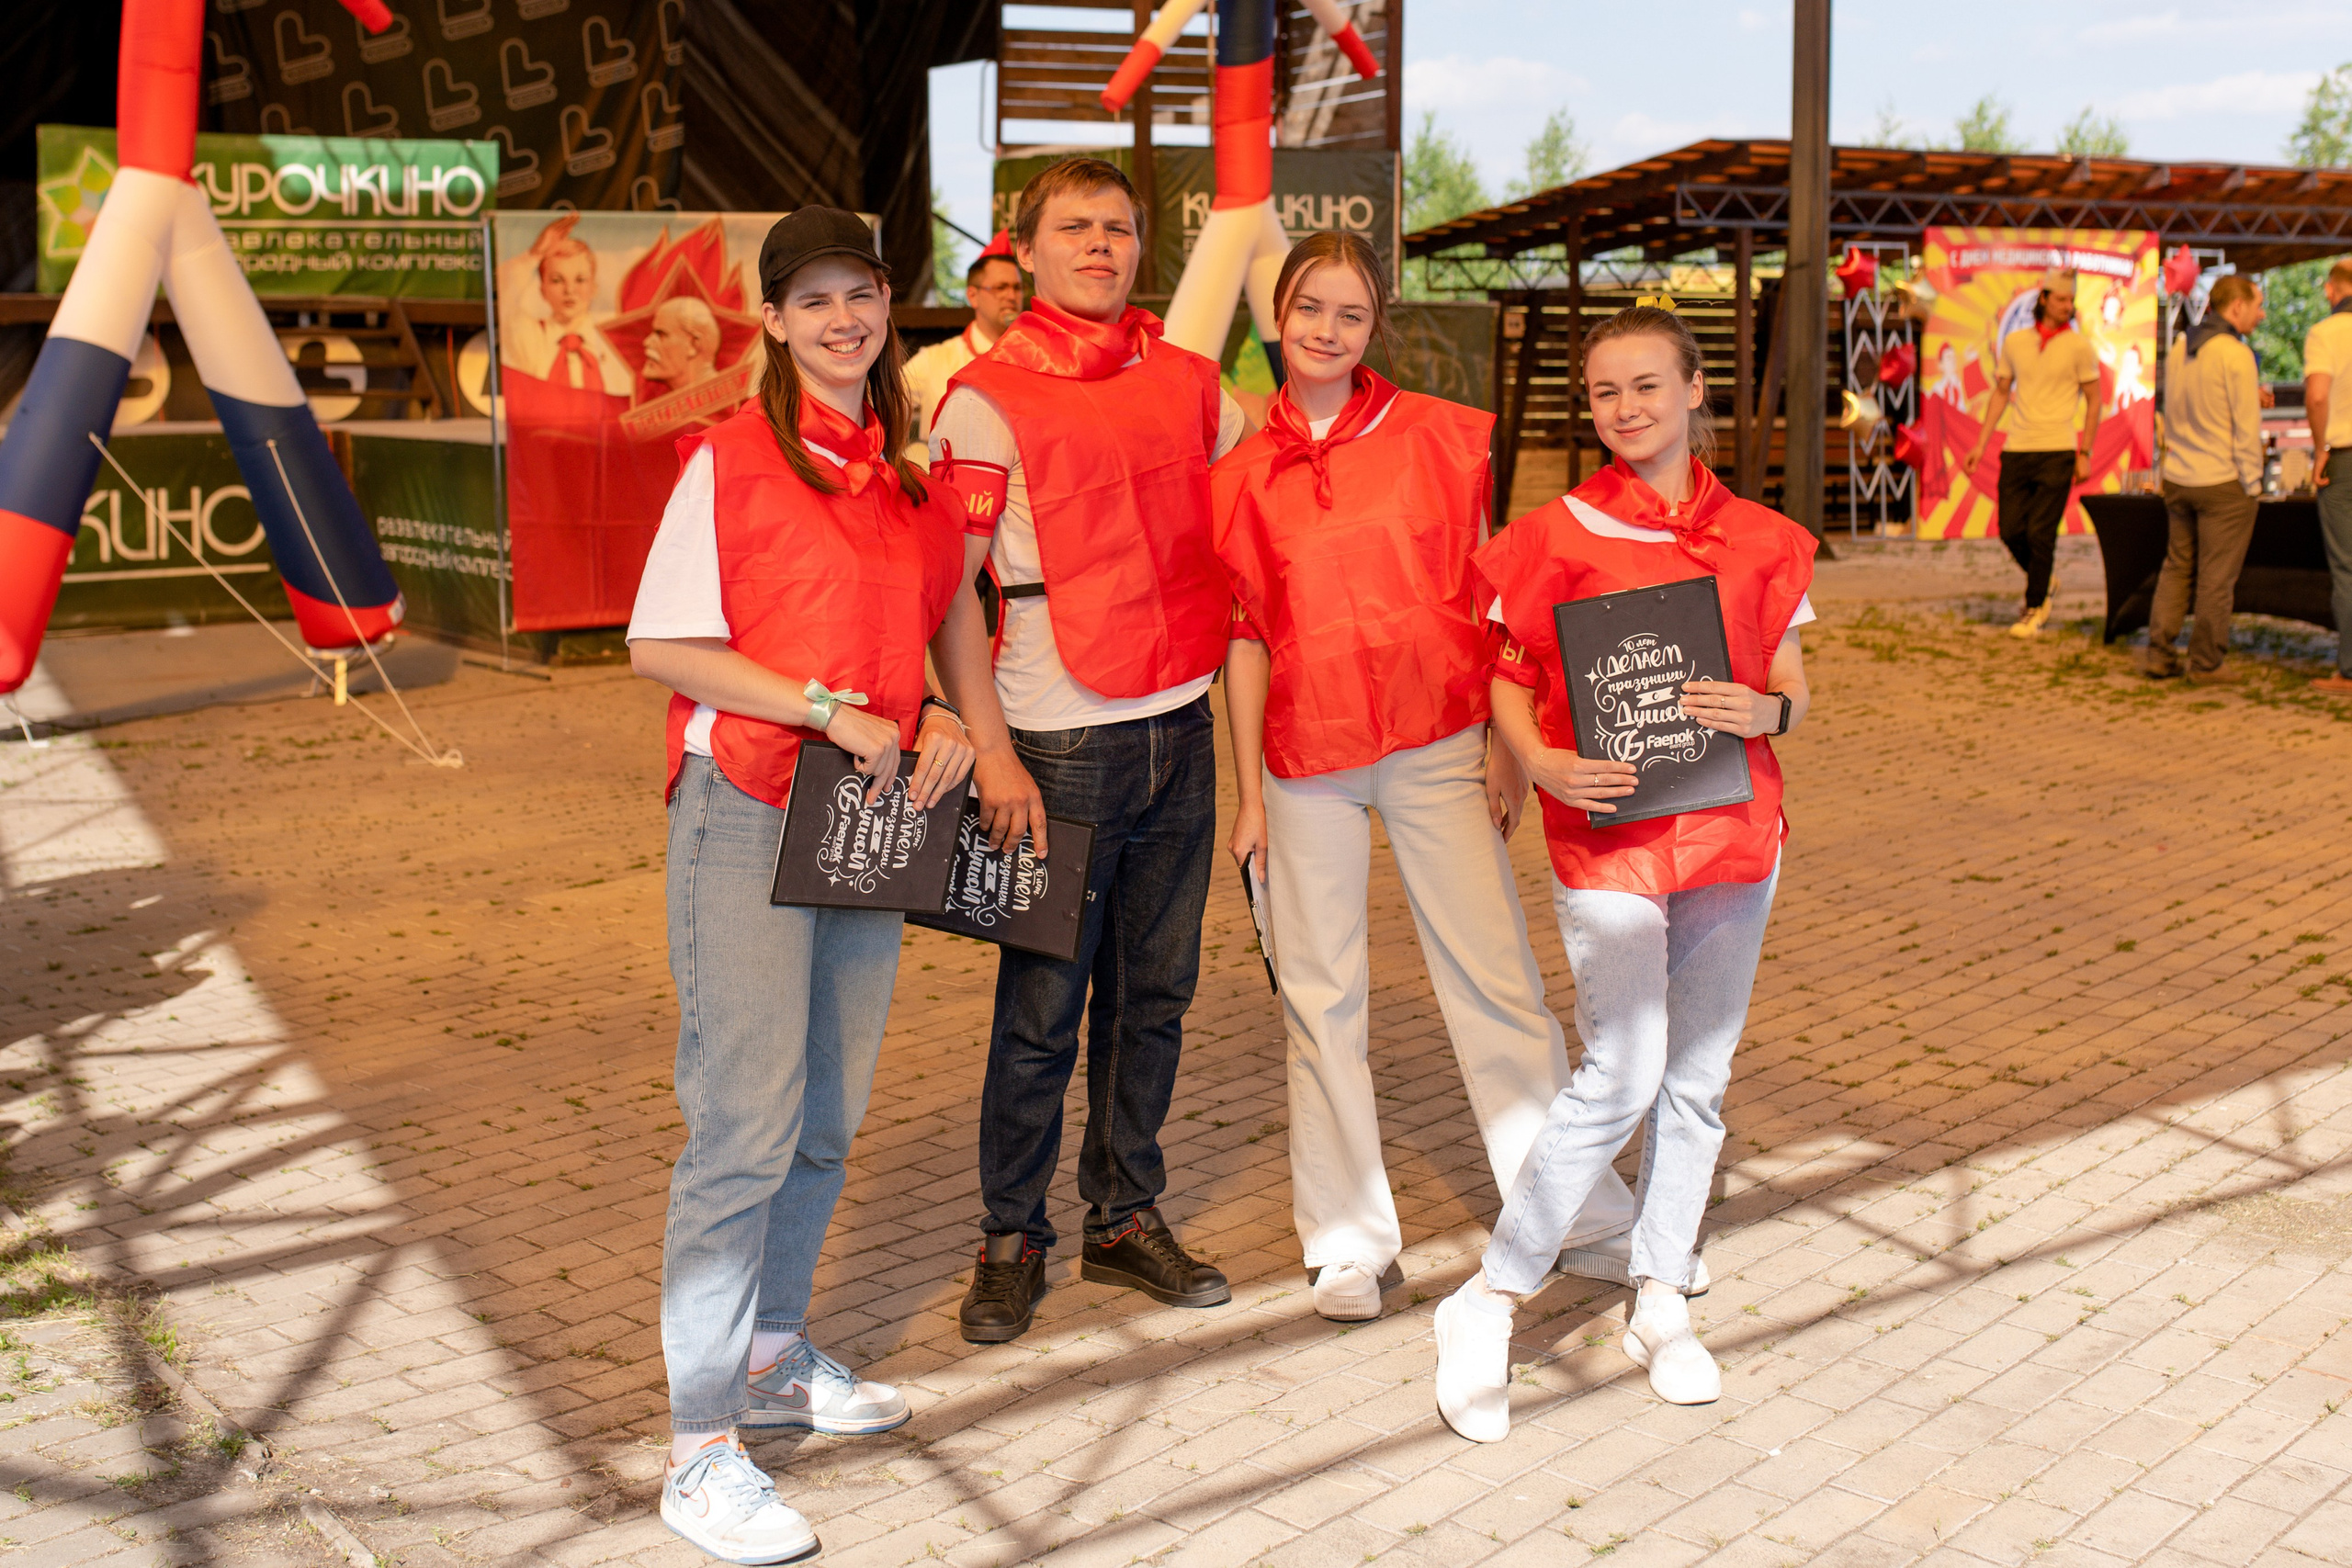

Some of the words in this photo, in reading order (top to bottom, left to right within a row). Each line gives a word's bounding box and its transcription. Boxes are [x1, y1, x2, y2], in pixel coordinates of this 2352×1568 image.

[357, 253, 484, 271] комплекс
[1623, 640, 1634, 652] 10
[1636, 638, 1657, 648] лет
[1608, 671, 1687, 694] праздники
[1646, 728, 1695, 749] Faenok
[880, 791, 901, 870] праздники
[916, 816, 925, 827] 10
[833, 814, 851, 864] Faenok
[1035, 867, 1045, 878] 10
